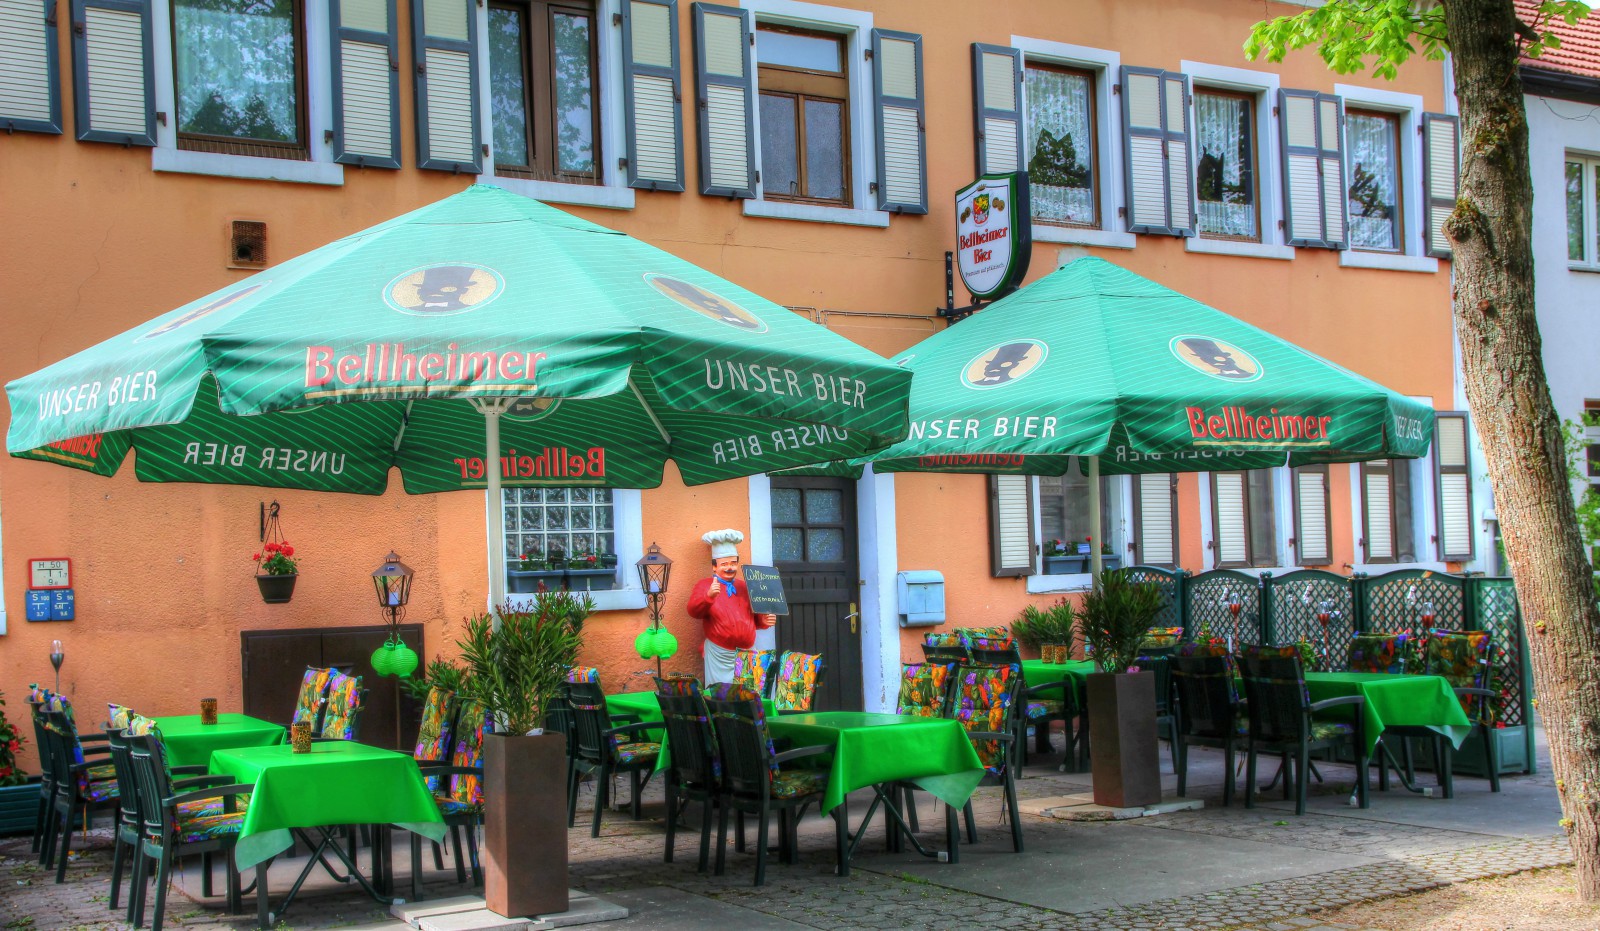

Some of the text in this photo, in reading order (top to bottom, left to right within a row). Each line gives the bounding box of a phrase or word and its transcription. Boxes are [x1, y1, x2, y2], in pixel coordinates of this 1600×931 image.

[960, 227, 1008, 250] Bellheimer
[974, 249, 992, 264] Bier
[305, 342, 547, 388] Bellheimer
[39, 370, 158, 421] UNSER BIER
[704, 358, 867, 409] UNSER BIER
[908, 416, 1058, 441] NSER BIER
[1185, 405, 1332, 440] Bellheimer
[745, 568, 780, 581] Willkommen
[759, 582, 768, 591] in
